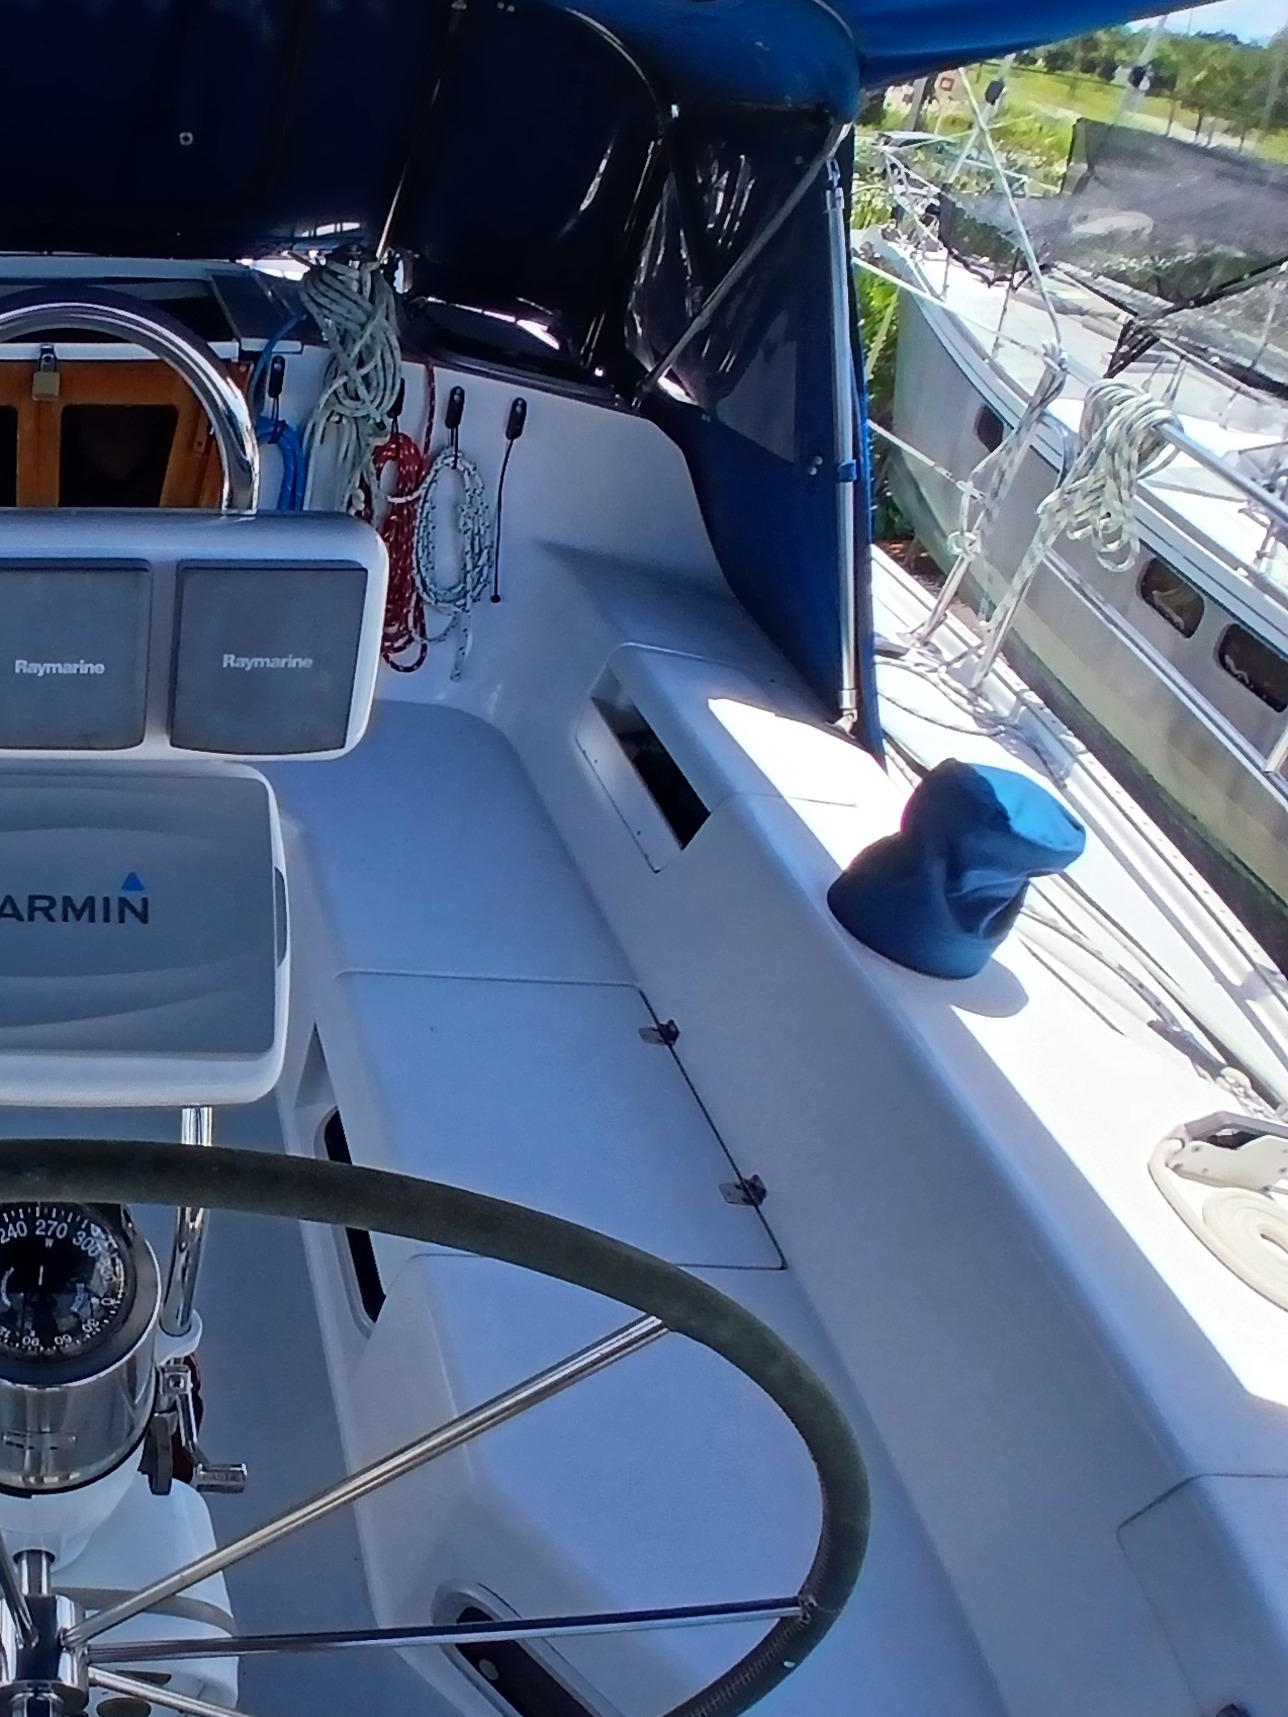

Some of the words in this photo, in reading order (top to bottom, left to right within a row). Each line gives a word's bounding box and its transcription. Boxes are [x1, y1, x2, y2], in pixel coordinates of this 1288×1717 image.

[14, 659, 105, 677] Raymarine
[222, 653, 314, 671] Raymarine
[35, 1219, 68, 1239] 270
[72, 1230, 102, 1257] 300
[22, 1336, 40, 1347] 90
[54, 1334, 72, 1345] 60
